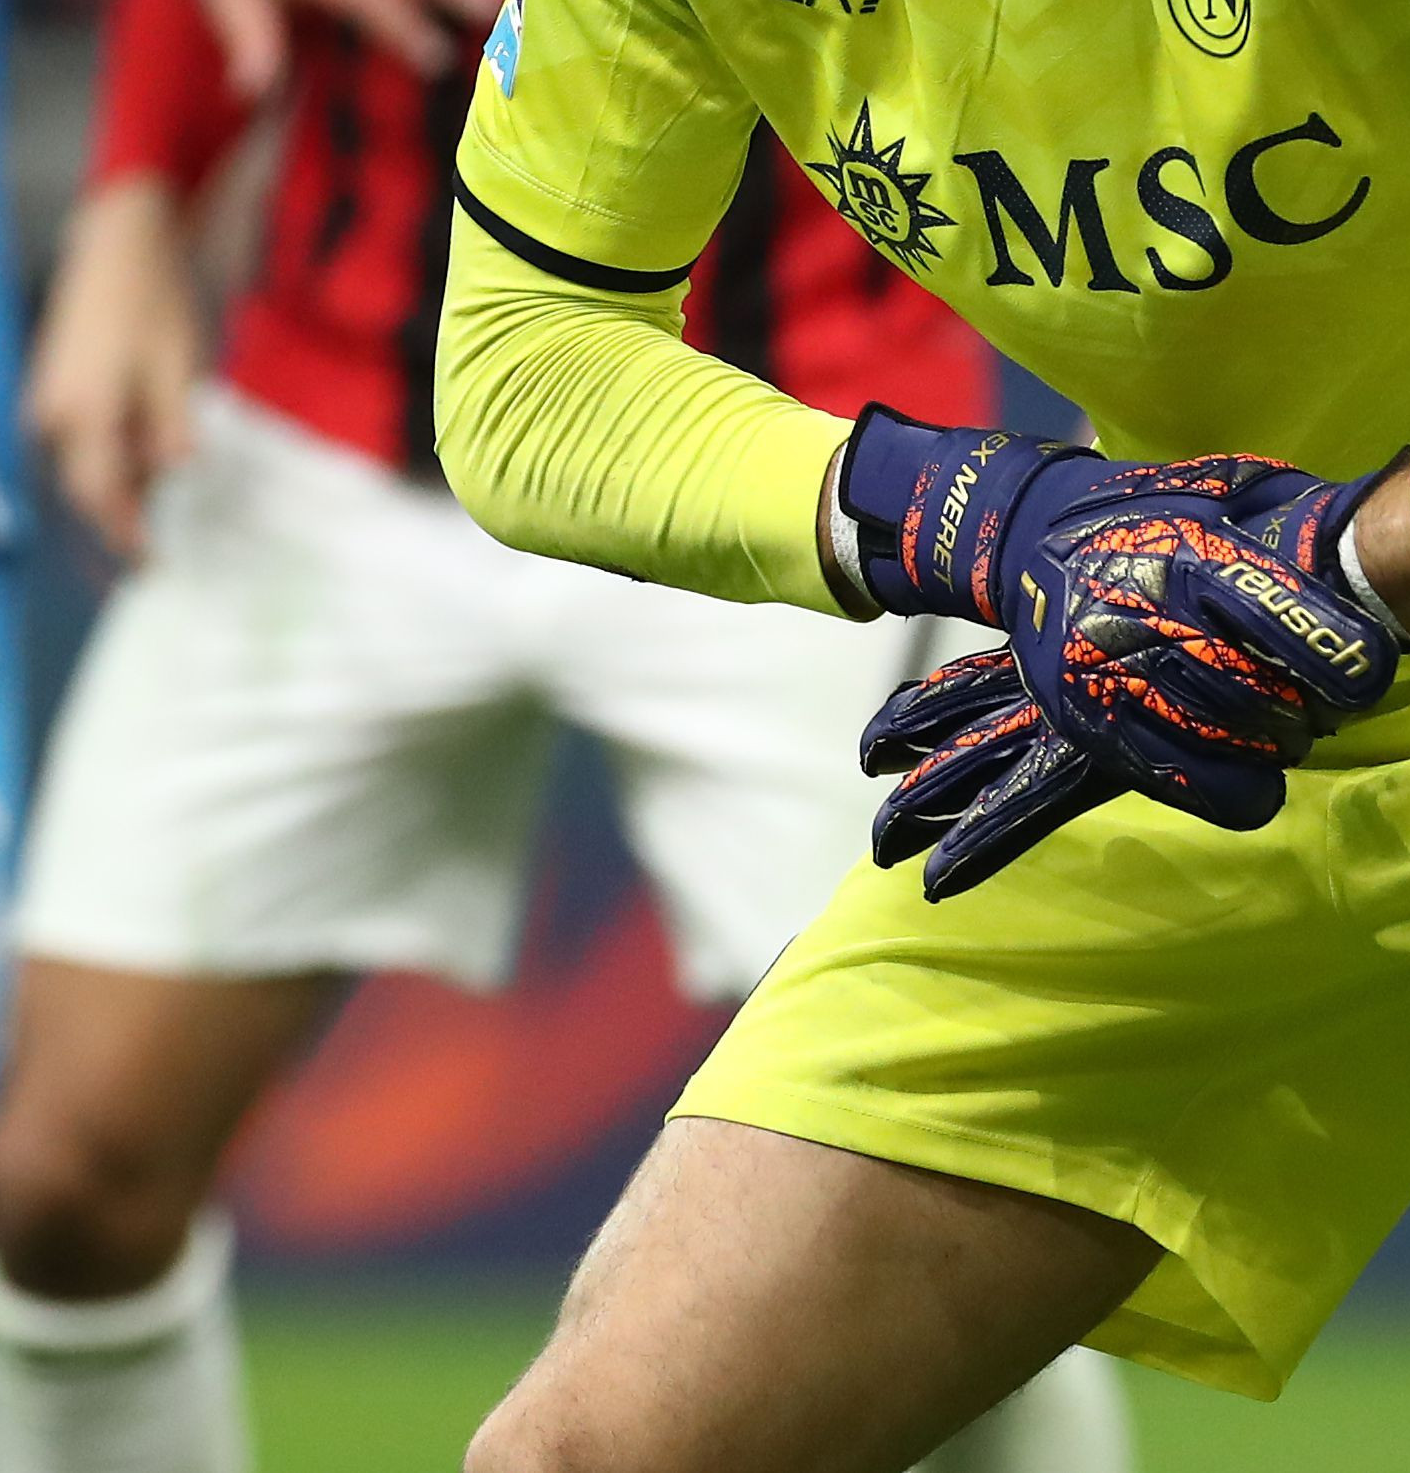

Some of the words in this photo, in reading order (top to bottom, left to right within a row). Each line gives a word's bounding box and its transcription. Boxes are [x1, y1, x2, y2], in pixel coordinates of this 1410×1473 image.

[953, 111, 1371, 294] MSC
[969, 431, 1022, 467] EX
[932, 463, 979, 594] MERET
[1219, 561, 1371, 677] reusch
